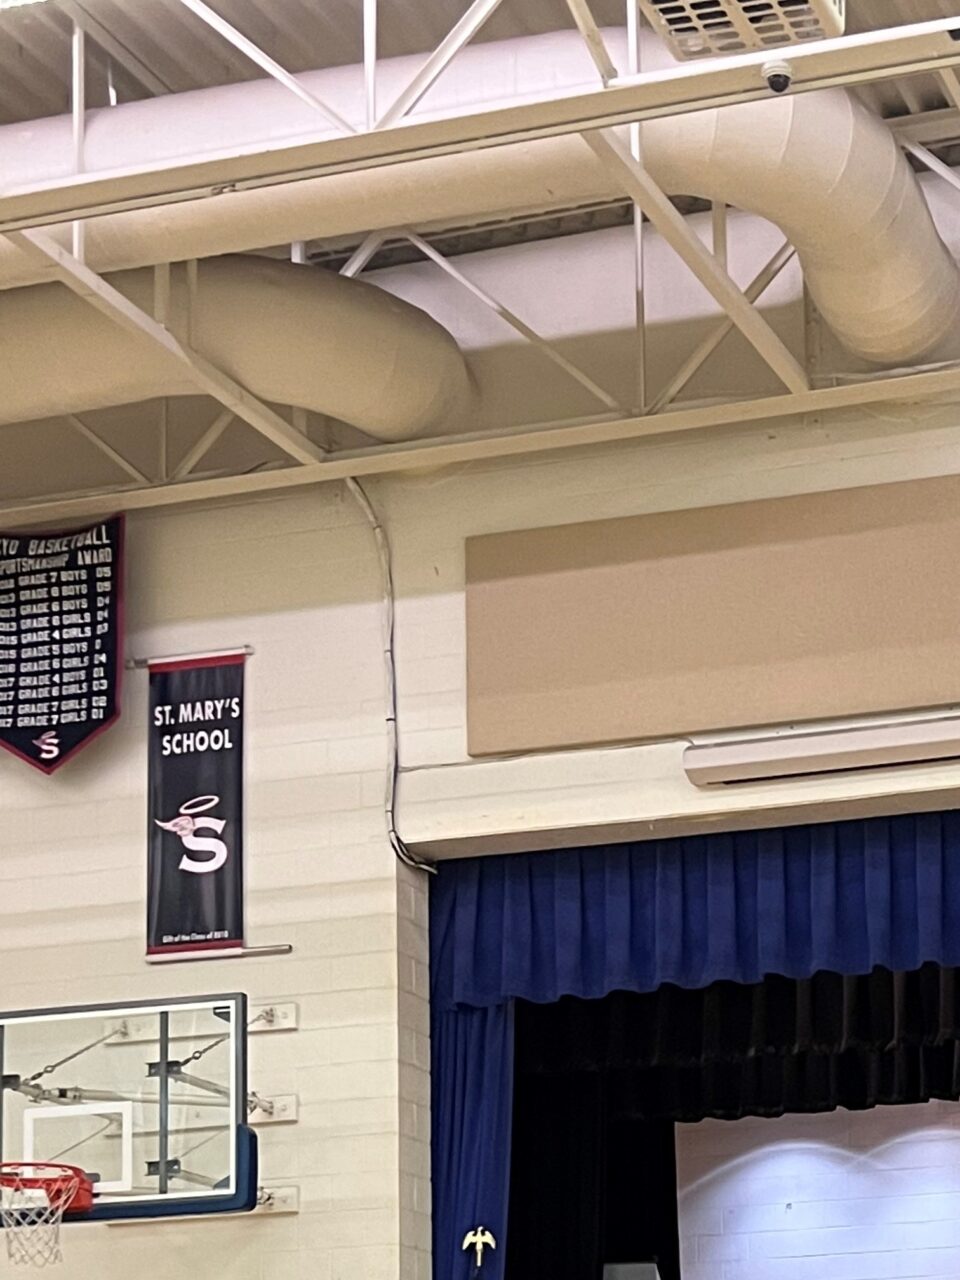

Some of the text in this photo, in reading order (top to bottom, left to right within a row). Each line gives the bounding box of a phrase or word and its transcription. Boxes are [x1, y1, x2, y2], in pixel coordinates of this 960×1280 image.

[0, 525, 111, 556] YO BASKETBALL
[77, 547, 112, 565] AWARD
[18, 573, 48, 586] GRADE
[49, 572, 58, 583] 7
[60, 569, 87, 581] BOYS
[19, 588, 49, 601] GRADE
[61, 584, 88, 596] BOYS
[20, 602, 50, 615] GRADE
[62, 598, 88, 610] BOYS
[21, 616, 50, 630] GRADE
[62, 612, 91, 625] GIRLS
[21, 631, 51, 644] GRADE
[52, 629, 60, 640] 4
[62, 626, 92, 639] GIRLS
[21, 646, 51, 659] GRADE
[52, 644, 60, 655] 5
[62, 641, 88, 654] BOYS
[20, 660, 51, 673] GRADE
[62, 656, 90, 669] GIRLS
[19, 674, 51, 686] GRADE
[52, 673, 60, 684] 4
[62, 670, 86, 682] BOYS
[18, 687, 51, 700] GRADE
[62, 682, 88, 695] GIRLS
[17, 702, 50, 714] GRADE
[51, 701, 59, 712] 7
[61, 698, 88, 711] GIRLS
[154, 697, 240, 726] ST. MARY'S
[17, 715, 49, 727] GRADE
[51, 714, 59, 725] 7
[60, 710, 87, 724] GIRLS
[162, 729, 233, 756] SCHOOL
